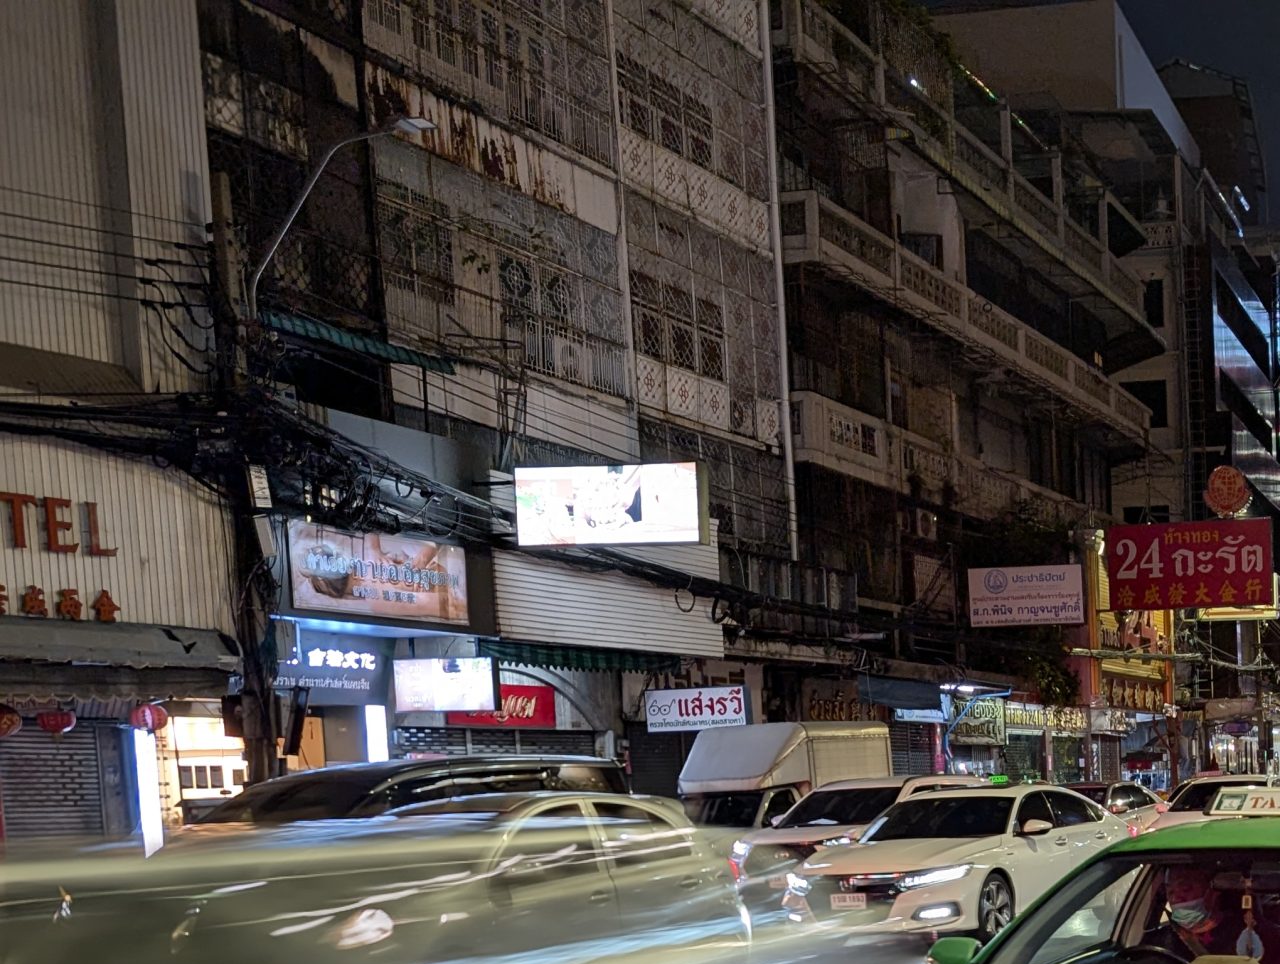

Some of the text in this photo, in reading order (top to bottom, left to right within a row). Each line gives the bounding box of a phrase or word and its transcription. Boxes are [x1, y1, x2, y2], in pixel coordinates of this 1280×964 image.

[0, 491, 119, 557] TEL
[1164, 527, 1220, 545] ห้างทอง
[1116, 535, 1264, 579] 24 กะรัต
[678, 688, 743, 717] แสงรวี
